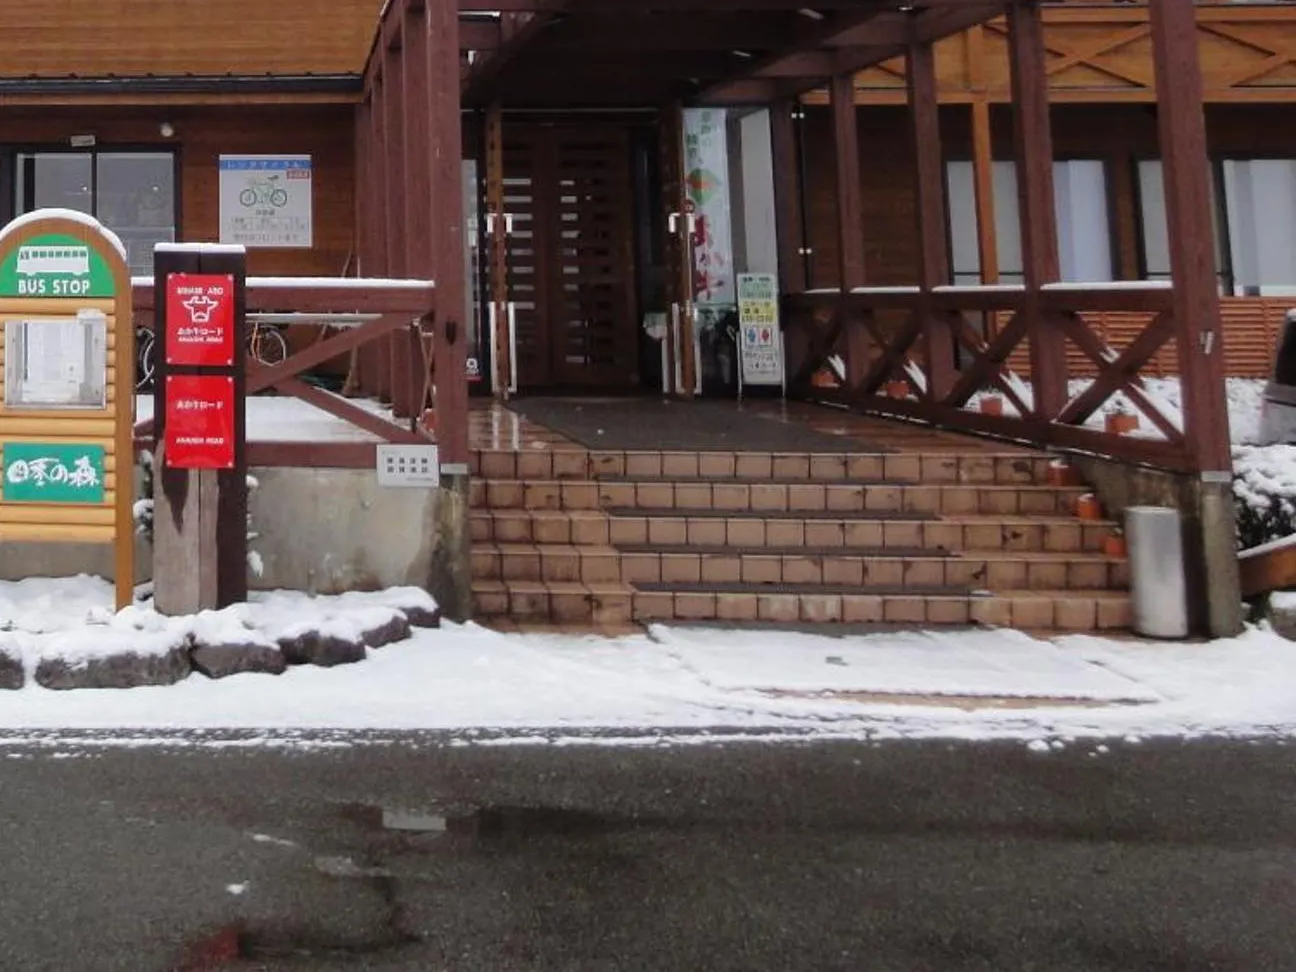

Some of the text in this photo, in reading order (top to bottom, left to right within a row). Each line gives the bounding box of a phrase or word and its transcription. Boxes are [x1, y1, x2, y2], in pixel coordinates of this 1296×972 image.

[18, 278, 91, 295] BUS STOP
[6, 455, 100, 488] 四季の森
